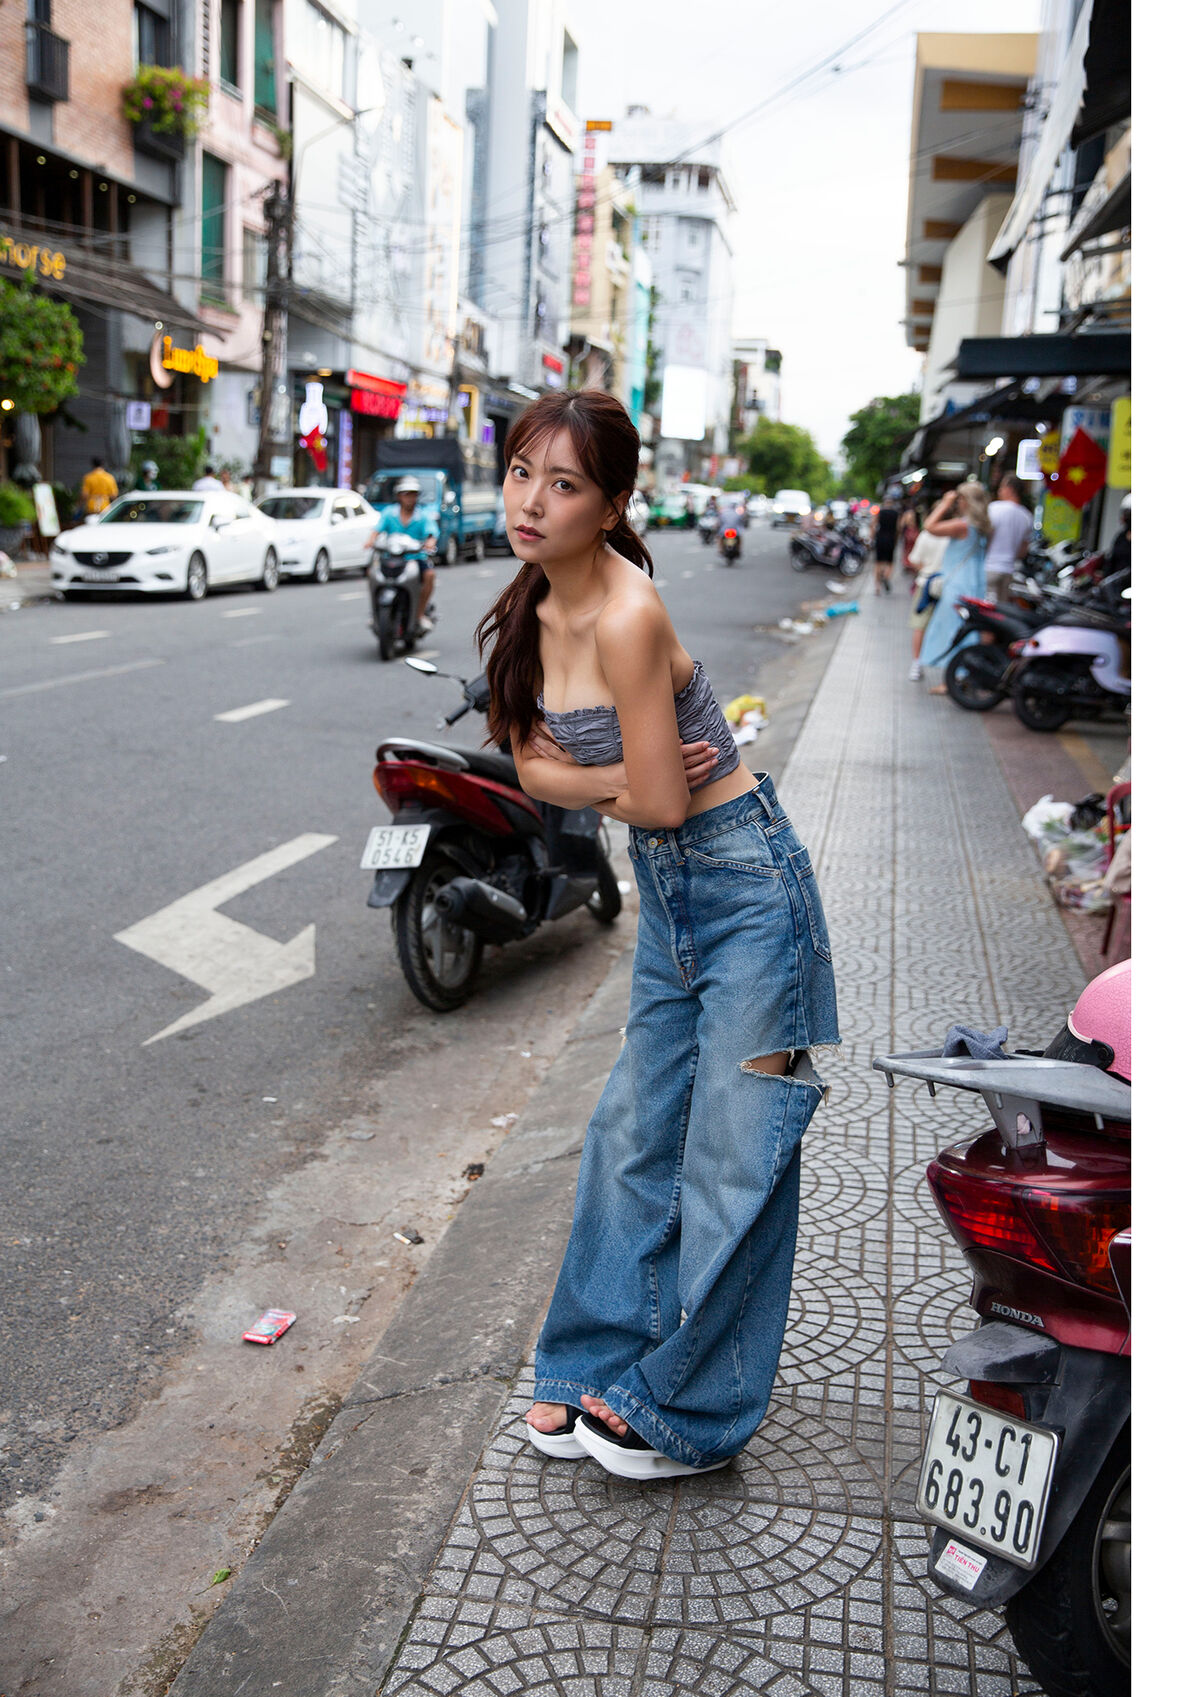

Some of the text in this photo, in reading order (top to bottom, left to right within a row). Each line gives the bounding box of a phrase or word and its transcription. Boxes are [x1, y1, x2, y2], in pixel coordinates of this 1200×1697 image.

[371, 848, 413, 866] 0546
[991, 1301, 1045, 1328] HONDA
[946, 1405, 1033, 1486] 43-C1
[925, 1458, 1035, 1555] 683.90
